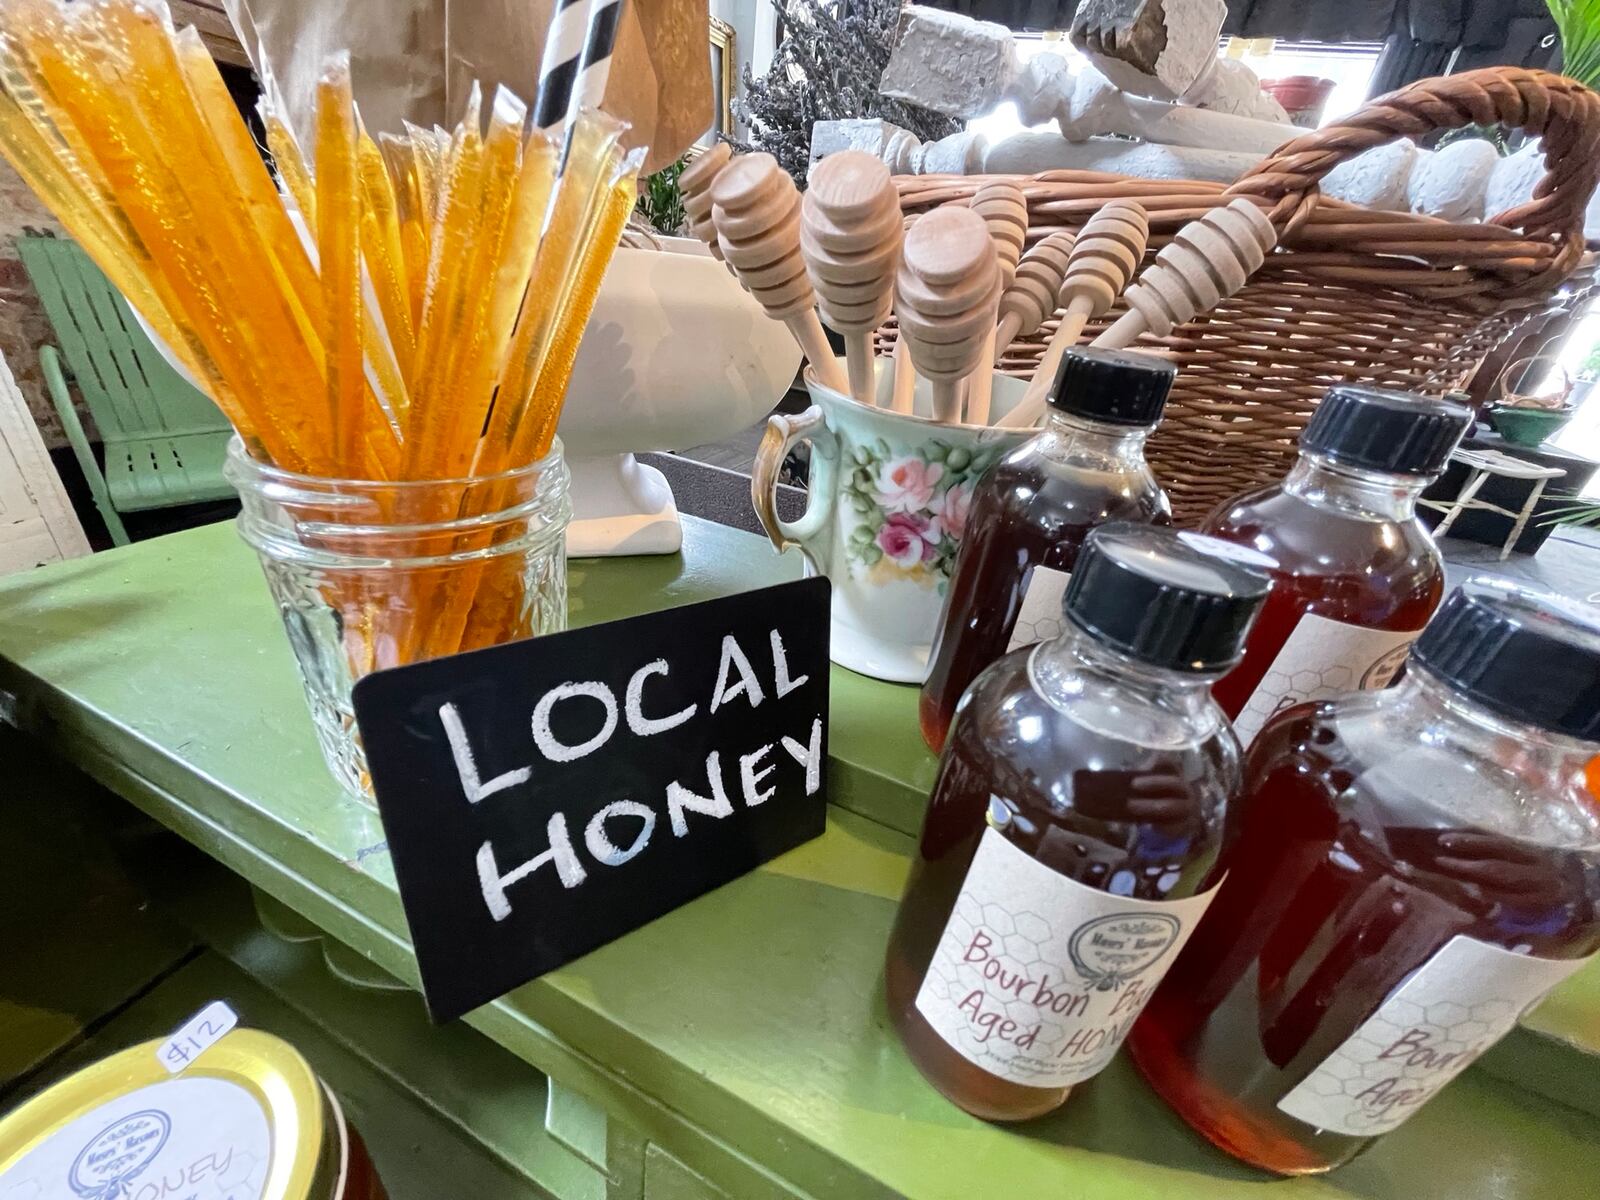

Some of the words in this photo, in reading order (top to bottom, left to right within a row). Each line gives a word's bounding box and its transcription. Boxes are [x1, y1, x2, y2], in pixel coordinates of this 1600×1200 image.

[438, 628, 810, 804] LOCAL
[475, 713, 823, 922] HONEY
[962, 930, 1091, 1018] Bourbon
[167, 1020, 225, 1064] $12
[957, 989, 1043, 1051] Aged
[127, 1144, 233, 1200] ONEY
